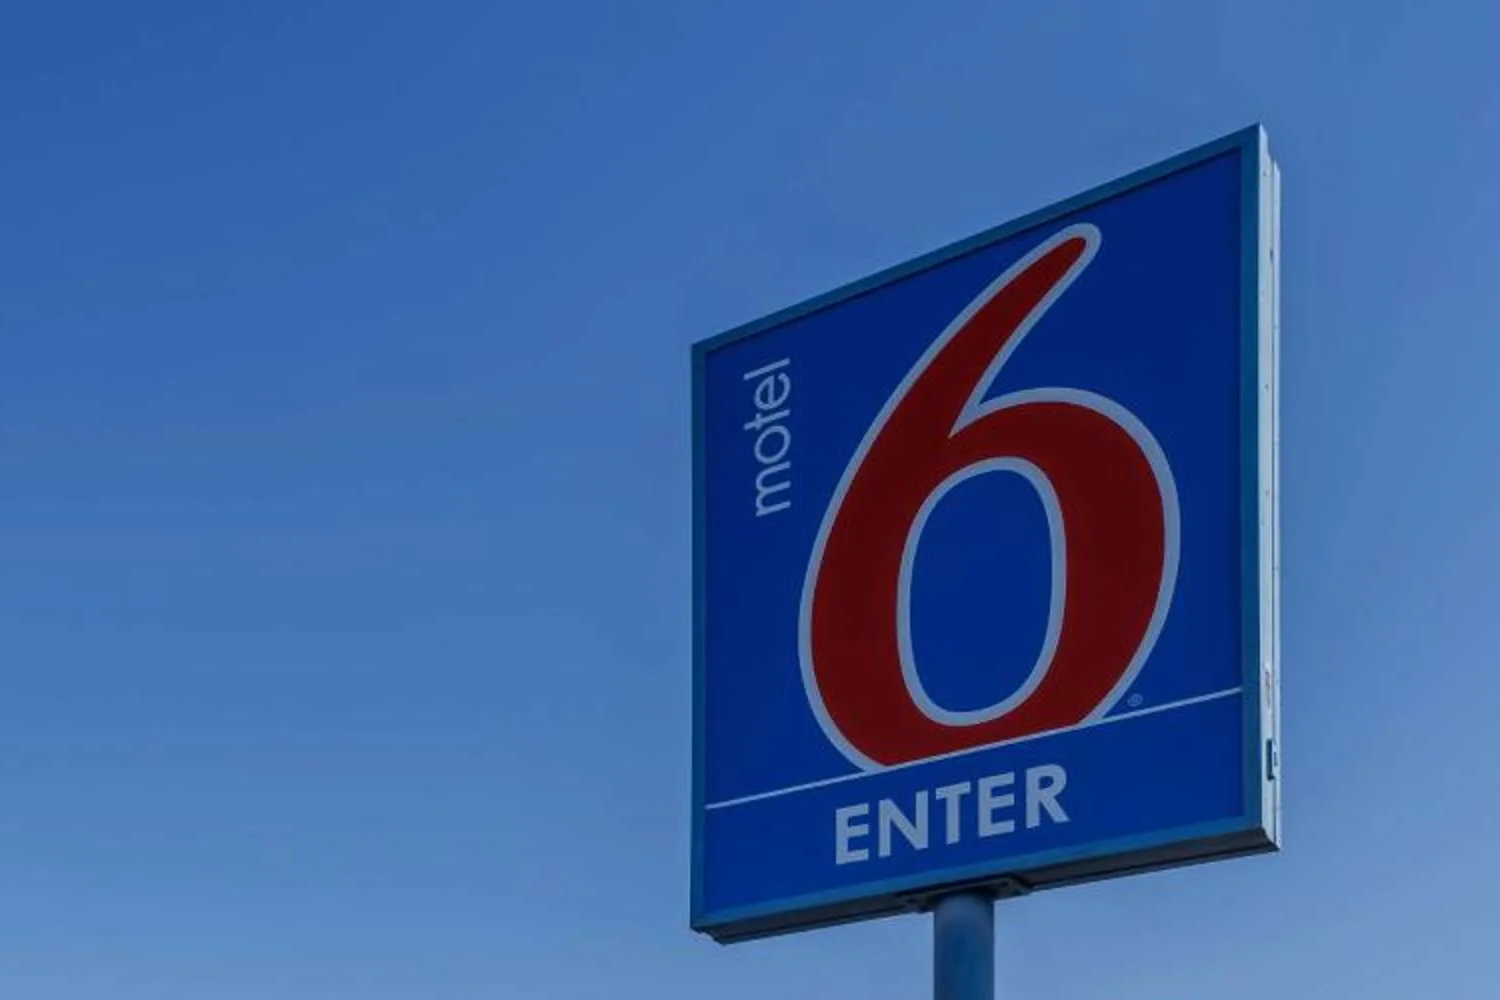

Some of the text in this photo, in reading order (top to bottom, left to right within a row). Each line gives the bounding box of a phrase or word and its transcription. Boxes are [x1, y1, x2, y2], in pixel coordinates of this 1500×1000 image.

[743, 223, 1181, 772] motel 6
[835, 763, 1071, 865] ENTER
